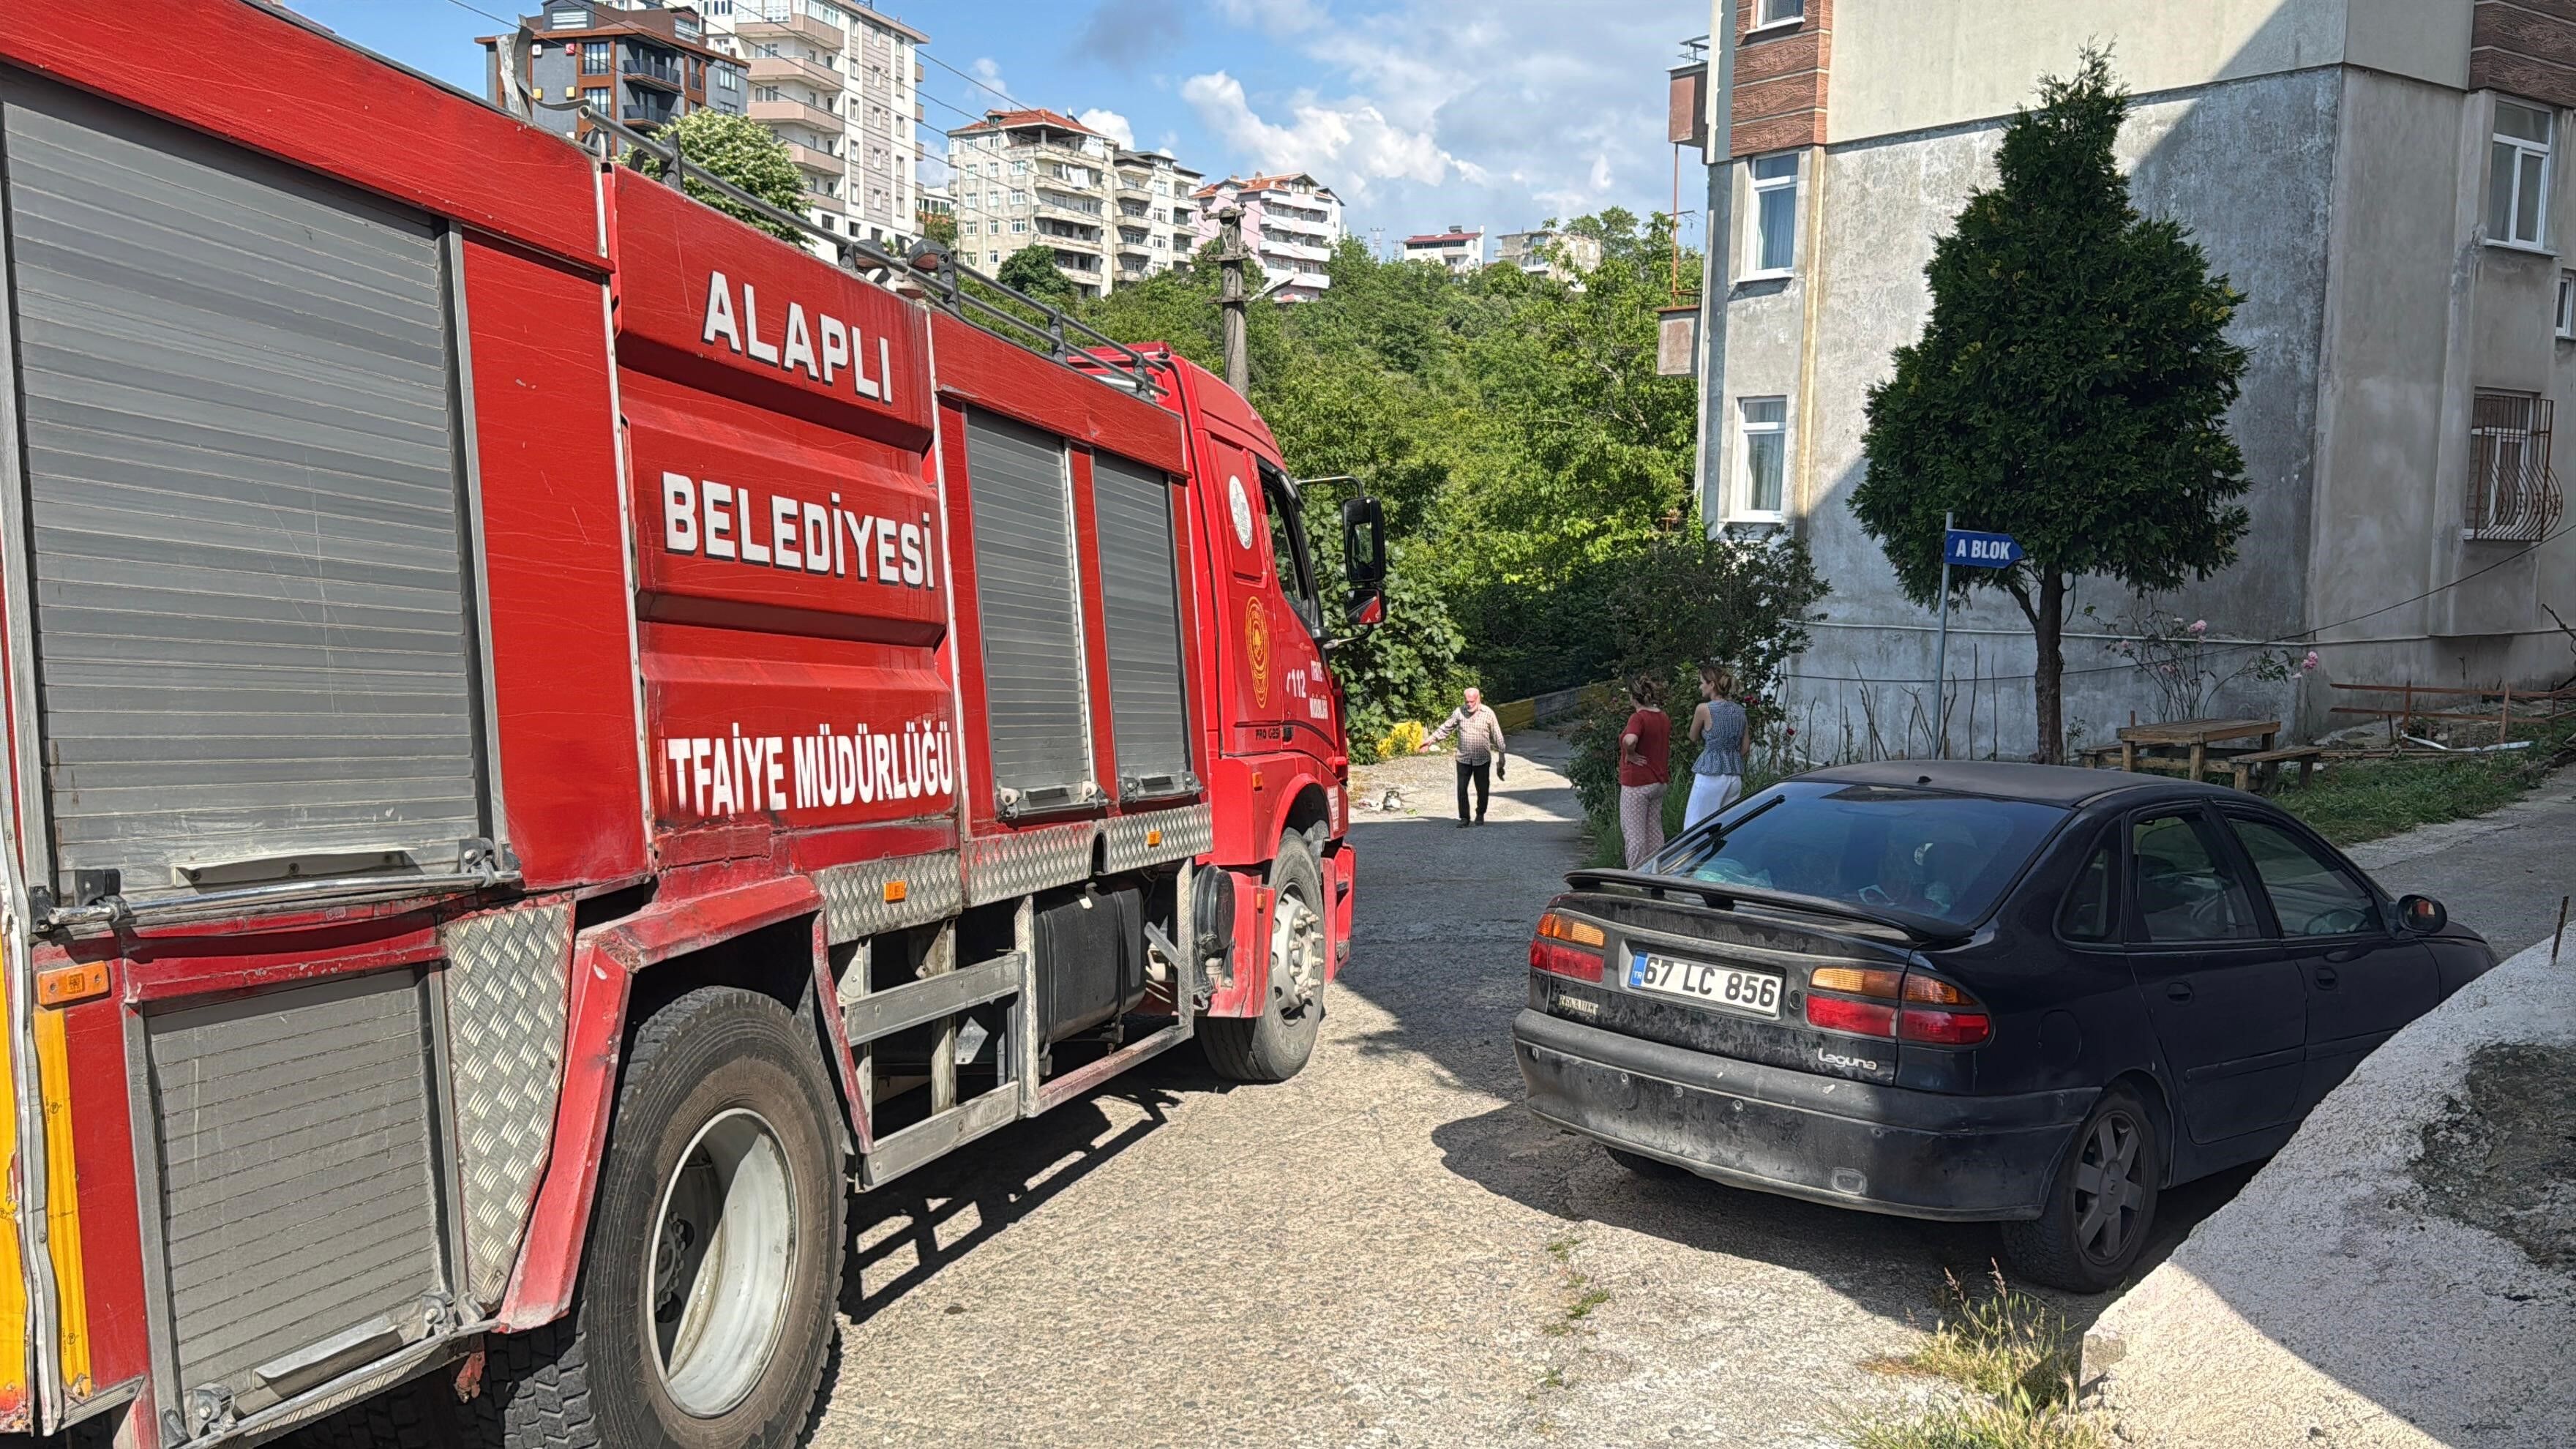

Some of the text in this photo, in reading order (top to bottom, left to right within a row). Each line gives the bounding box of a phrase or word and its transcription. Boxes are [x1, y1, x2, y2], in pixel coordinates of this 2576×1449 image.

[701, 270, 893, 405] ALAPLI
[661, 471, 935, 590] BELEDİYESİ
[1955, 539, 2012, 561] A BLOK
[1291, 668, 1307, 699] 112
[793, 719, 954, 809] MÜDÜRLÜĞÜ
[1644, 956, 1674, 987] 67
[1682, 964, 1716, 996] LC
[1725, 972, 1778, 1008] 856
[1817, 1047, 1877, 1071] Laguna
